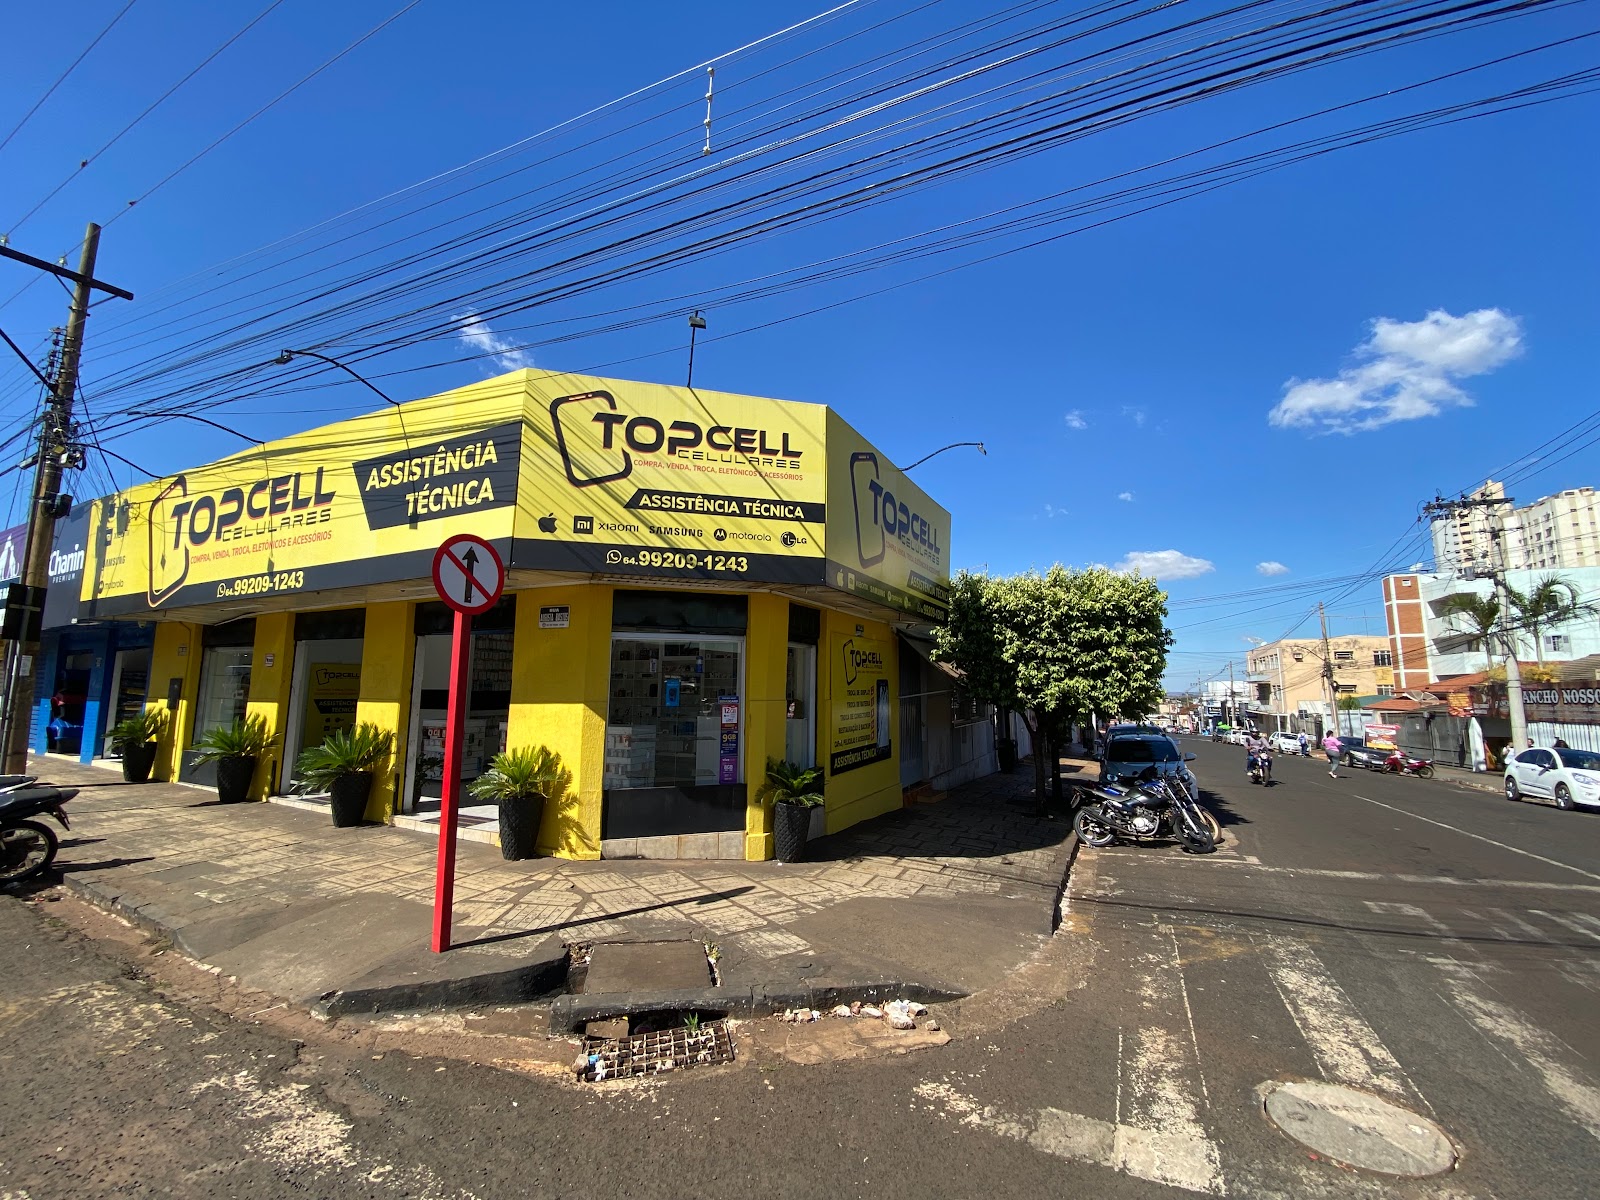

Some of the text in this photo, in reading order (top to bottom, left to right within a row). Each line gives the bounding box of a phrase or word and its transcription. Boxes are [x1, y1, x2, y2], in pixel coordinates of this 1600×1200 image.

[591, 412, 803, 458] TOPCELL
[365, 439, 498, 492] ASSISTÊNCIA
[633, 459, 665, 469] COMPRA,
[666, 462, 691, 471] VENDA,
[692, 464, 717, 474] TROCA,
[764, 471, 803, 481] ACESSÓRIOS
[677, 450, 800, 469] CELULARES
[171, 466, 337, 550] TOPCELL
[405, 477, 495, 517] TÉCNICA
[639, 493, 805, 519] ASSISTÊNCIA TÉCNICA
[222, 508, 331, 542] CELULARES
[868, 478, 941, 556] TOPCELL
[649, 525, 703, 538] SAMSUNG
[729, 530, 772, 542] motorola
[796, 537, 807, 545] LG
[190, 551, 212, 564] COMPRA,
[212, 548, 231, 561] VENDA,
[232, 545, 251, 557] TROCA,
[292, 530, 332, 545] ACESSÓRIOS
[48, 544, 85, 577] Chanin
[52, 573, 76, 584] PREMIUM
[849, 649, 883, 667] TOPCELL
[324, 671, 360, 679] TOPCELL
[1522, 689, 1559, 704] ANCHO
